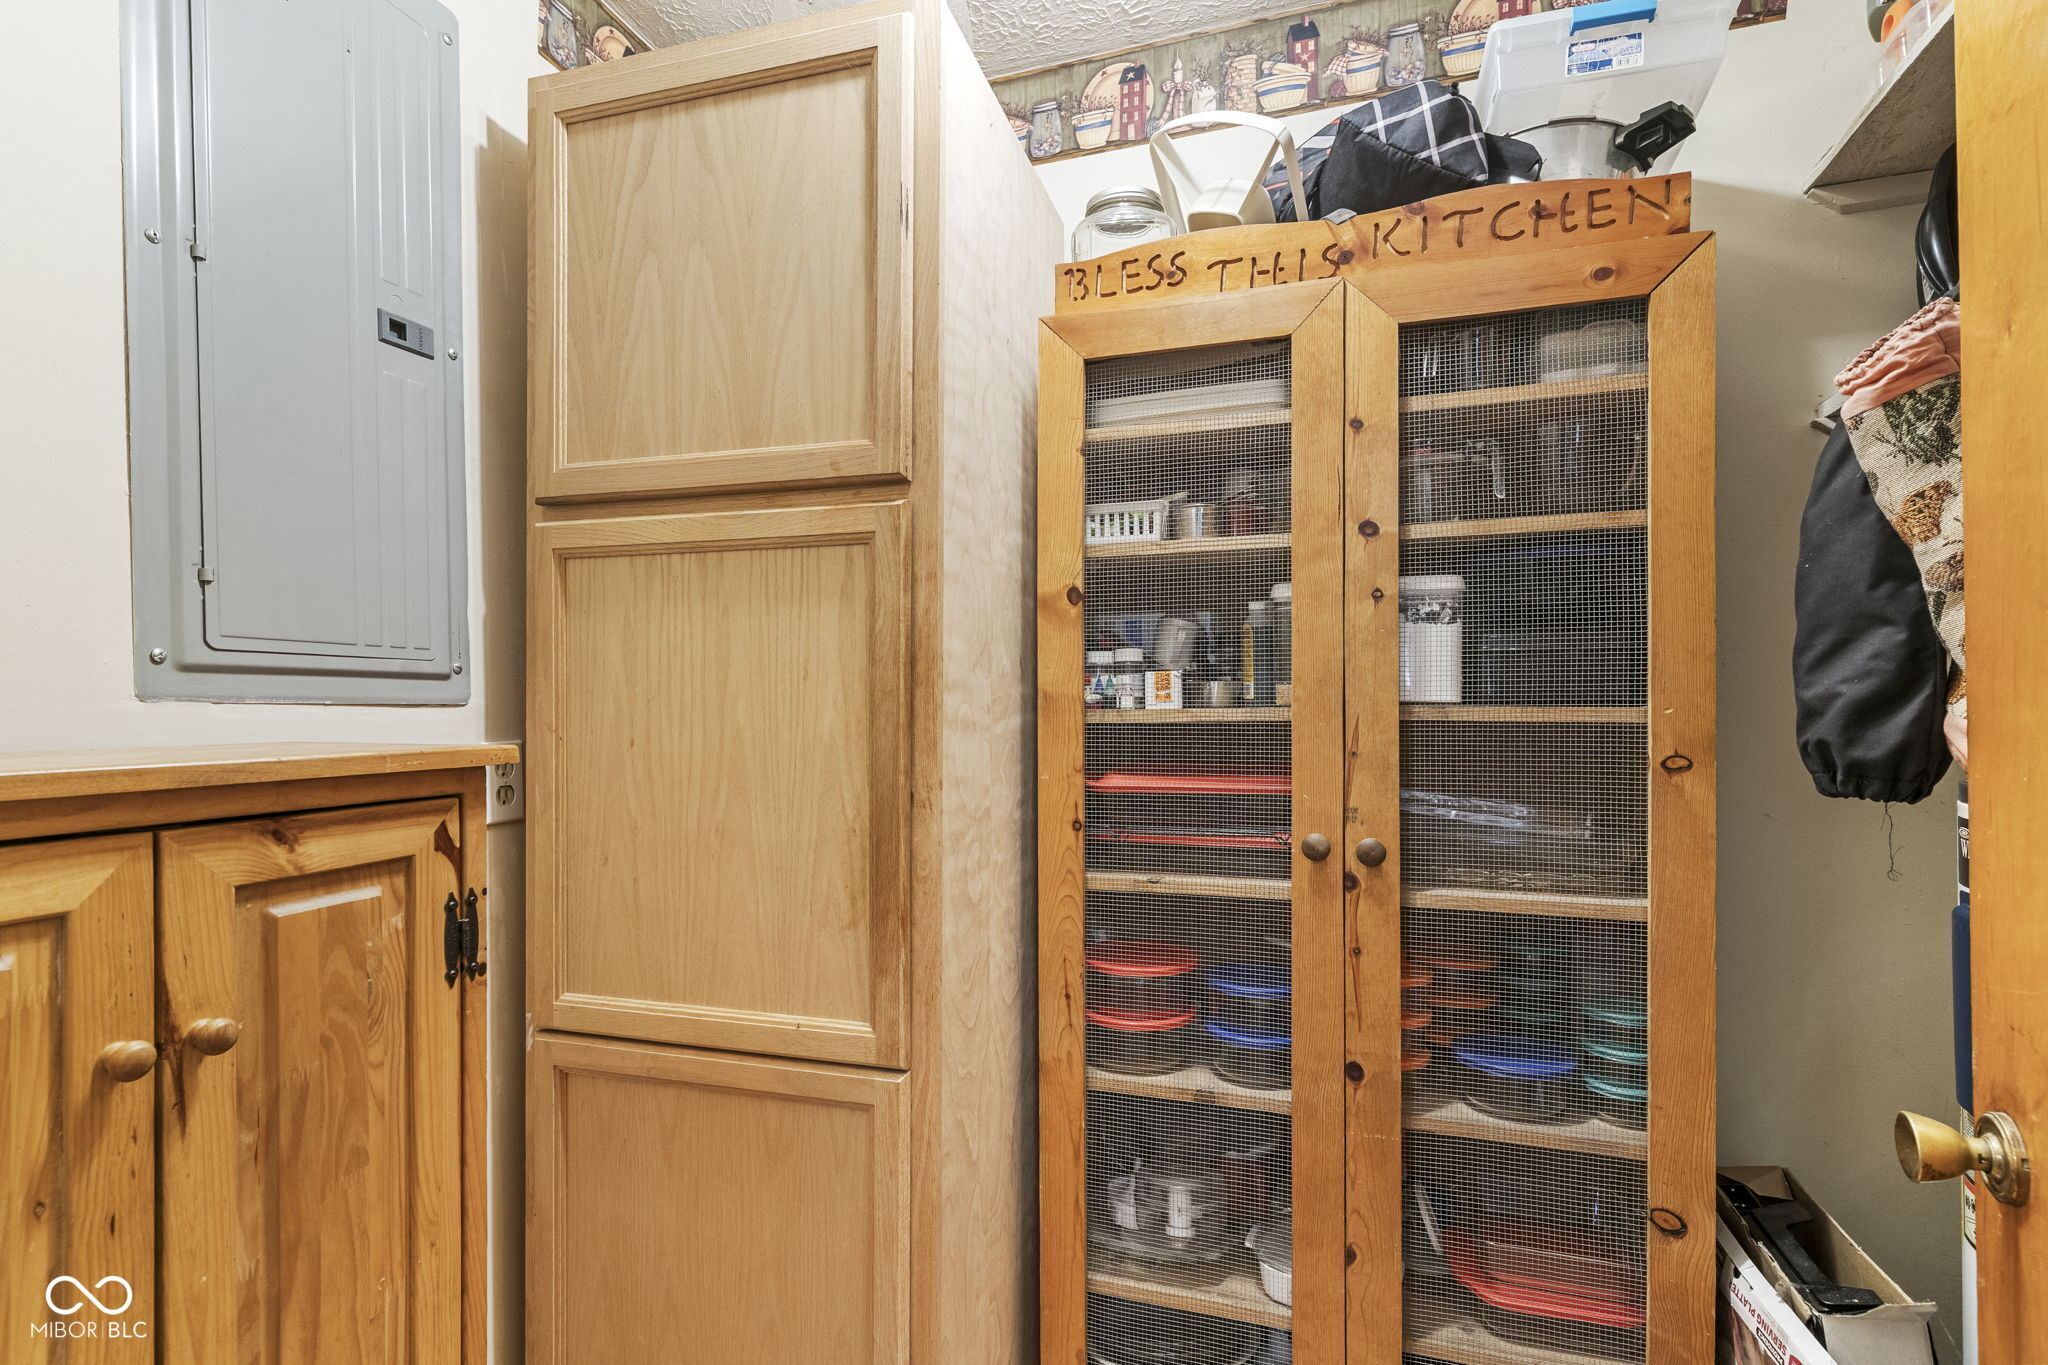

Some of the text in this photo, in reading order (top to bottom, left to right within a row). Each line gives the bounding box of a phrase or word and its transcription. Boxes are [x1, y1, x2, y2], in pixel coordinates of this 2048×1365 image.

[1064, 178, 1672, 301] BLESS THIS KITCHEN
[1756, 1313, 1788, 1357] SERVING
